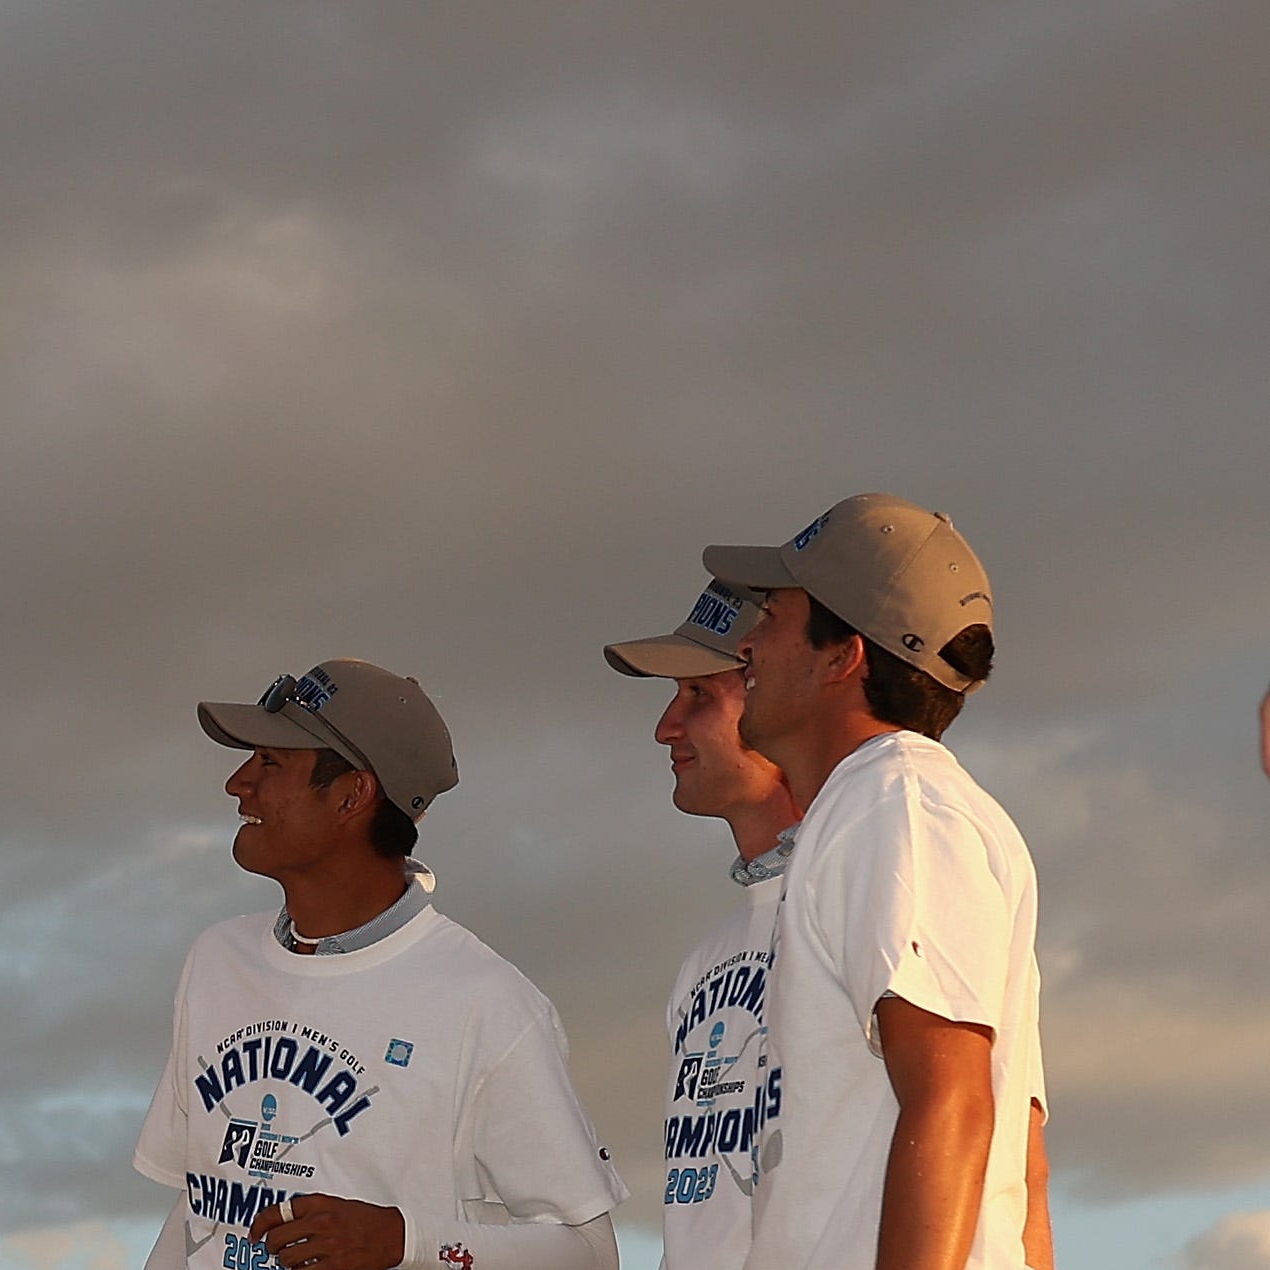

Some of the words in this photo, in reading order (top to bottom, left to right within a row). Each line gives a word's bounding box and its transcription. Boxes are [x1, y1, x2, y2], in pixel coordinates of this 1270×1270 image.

[714, 951, 748, 975] DIVISION
[216, 1029, 244, 1054] NCAA
[245, 1020, 289, 1037] DIVISION
[291, 1023, 298, 1034] I
[301, 1026, 339, 1052] MEN'S
[339, 1049, 366, 1076] GOLF
[194, 1036, 372, 1138] NATIONAL
[253, 1140, 279, 1159] GOLF
[249, 1157, 315, 1178] CHAMPIONSHIPS
[664, 1163, 720, 1205] 2023
